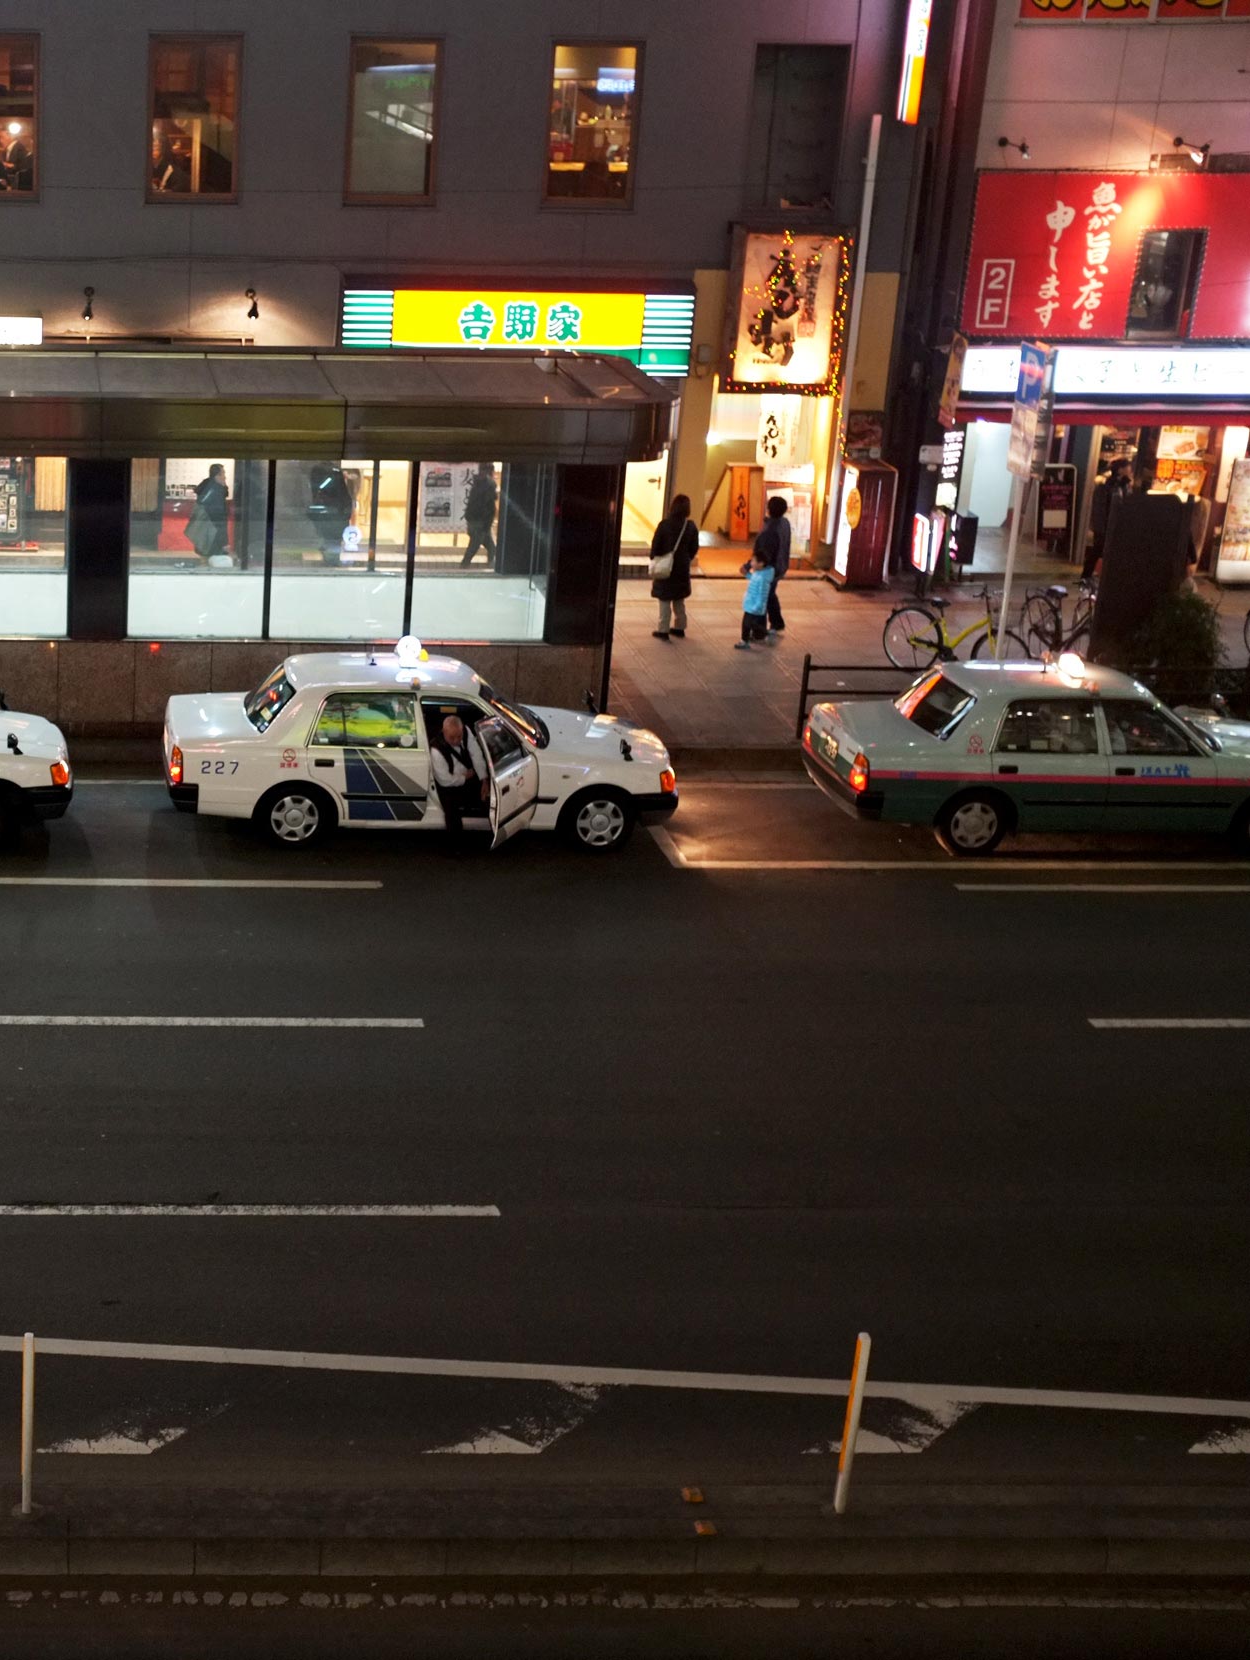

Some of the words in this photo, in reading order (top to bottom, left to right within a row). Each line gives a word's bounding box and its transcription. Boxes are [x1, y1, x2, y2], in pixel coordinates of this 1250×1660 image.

[1034, 201, 1075, 328] 申します
[1072, 182, 1122, 330] 魚が旨い店と
[983, 267, 1006, 320] 2F
[458, 302, 584, 342] 吉野家
[201, 761, 239, 775] 227
